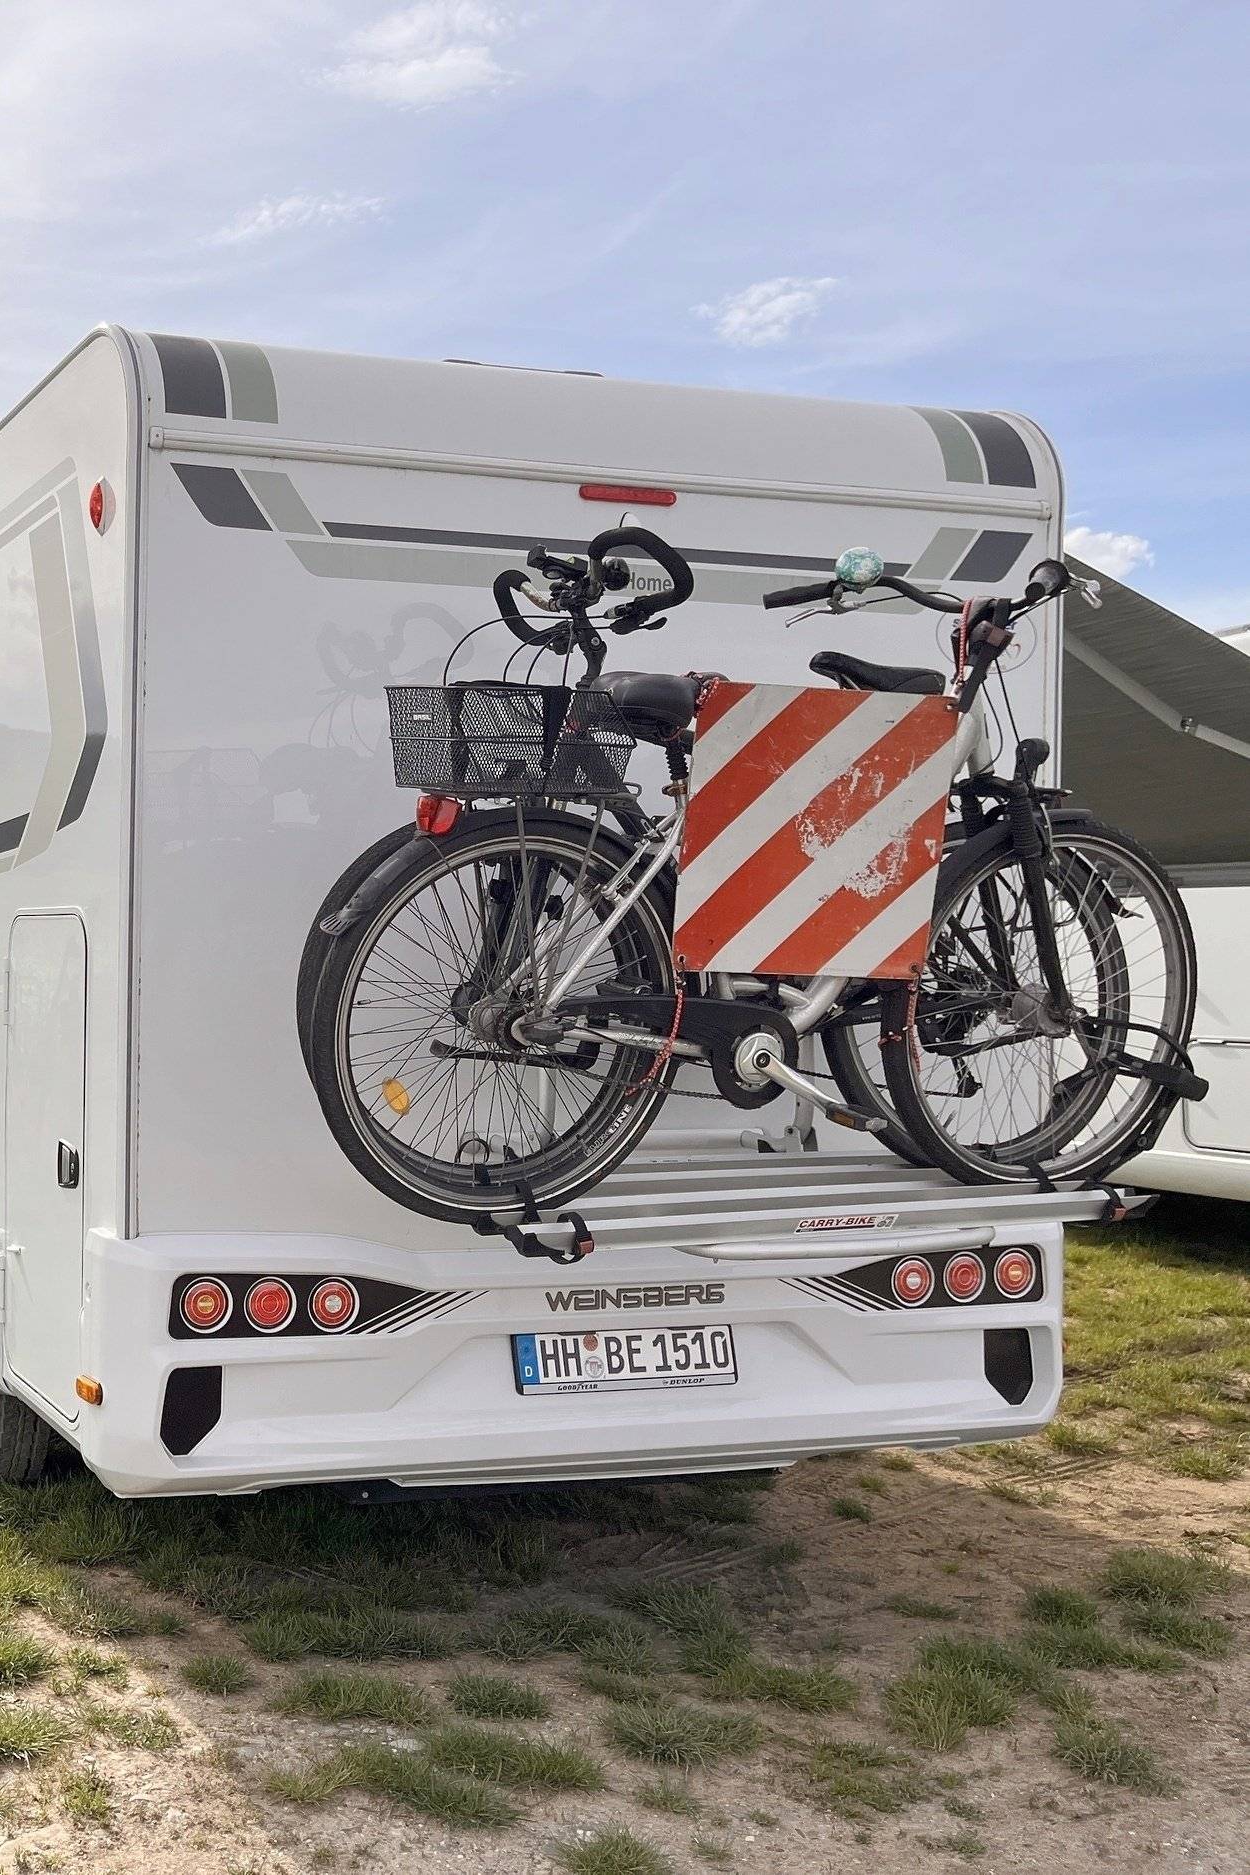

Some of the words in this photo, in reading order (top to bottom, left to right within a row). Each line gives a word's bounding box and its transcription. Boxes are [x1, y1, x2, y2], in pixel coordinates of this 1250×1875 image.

[799, 1215, 877, 1229] CARRY-BIKE
[545, 1283, 726, 1312] WEINSBERG
[539, 1337, 583, 1378] HH
[604, 1334, 647, 1375] BE
[652, 1330, 730, 1373] 1510
[524, 1365, 533, 1378] D
[557, 1382, 599, 1392] GOODYEAR
[669, 1377, 705, 1386] DUNLOP
